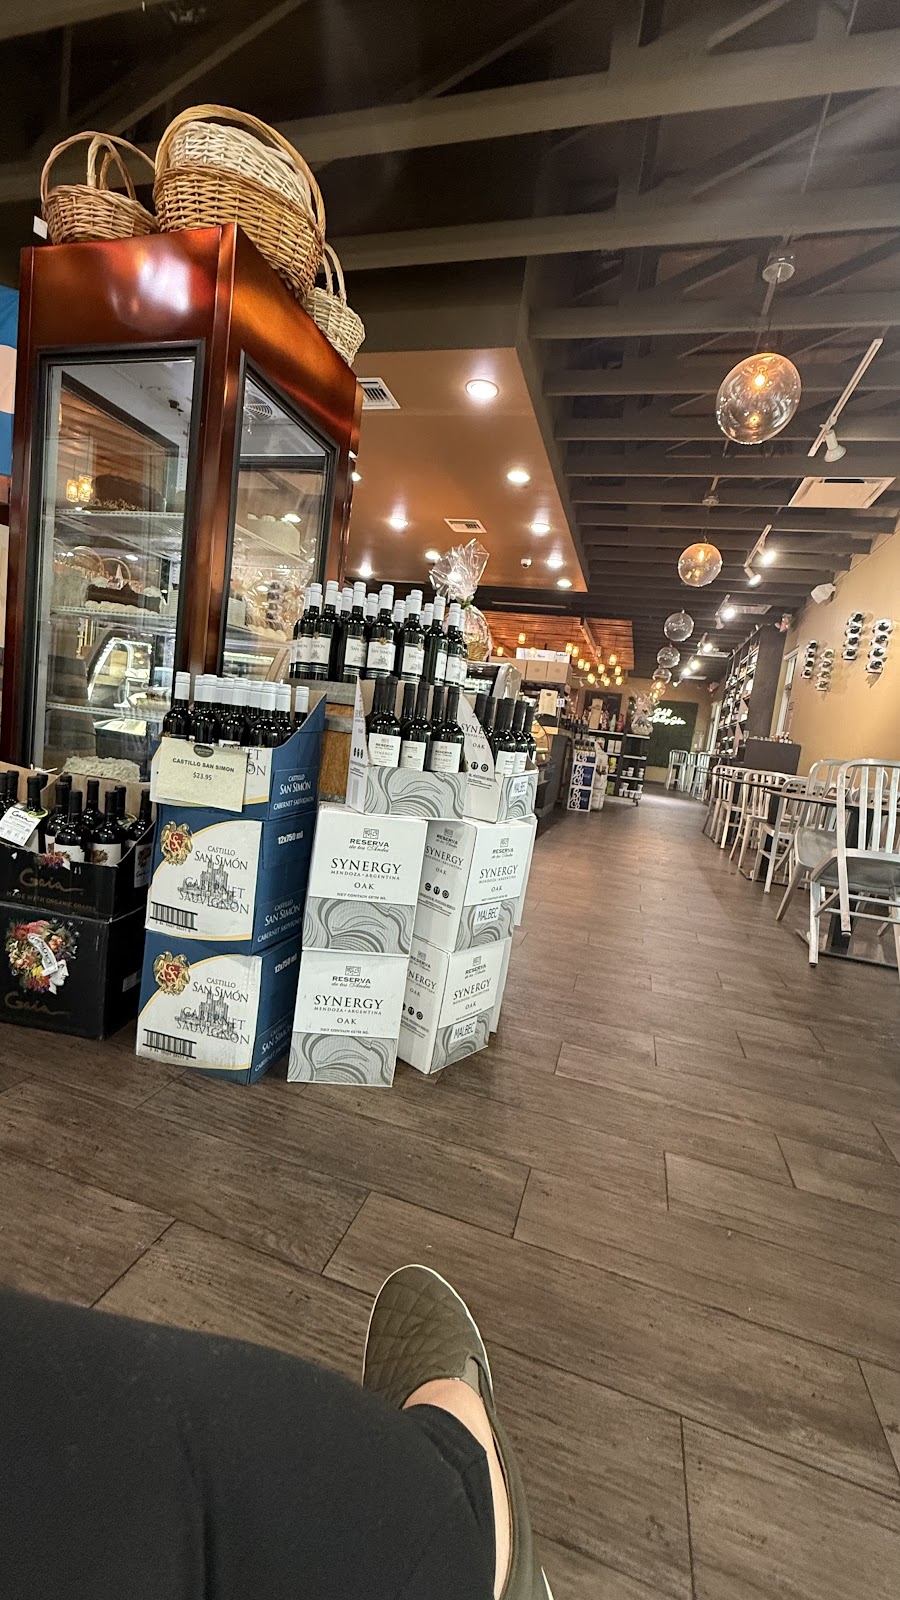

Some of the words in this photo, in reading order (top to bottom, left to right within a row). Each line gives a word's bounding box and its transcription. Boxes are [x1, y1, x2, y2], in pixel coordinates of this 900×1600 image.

[172, 757, 202, 767] CASTILLO
[215, 764, 235, 773] SIMON
[193, 771, 213, 781] $23.95
[287, 773, 306, 782] CASTILLO
[279, 783, 292, 795] SAN
[273, 800, 294, 811] CABERNET
[277, 833, 296, 845] 12x750
[349, 838, 390, 848] RESERVA
[436, 834, 458, 845] RESERVA
[207, 845, 236, 857] CASTILLO
[425, 845, 465, 867] SYNERGY
[491, 847, 514, 855] RESERVA
[194, 850, 213, 863] SAN
[214, 854, 249, 871] SIMÓN
[330, 857, 402, 875] SYNERGY
[330, 870, 362, 878] MENDOZA
[365, 873, 401, 881] ARGENTINA
[435, 866, 448, 876] OAK
[479, 864, 519, 879] SYNERGY
[184, 876, 246, 899] CABERNET
[354, 881, 375, 890] OAK
[490, 885, 503, 893] OAK
[178, 890, 250, 915] SAUVIGNON
[264, 912, 279, 927] SAN
[477, 906, 499, 921] MALBEC
[257, 924, 281, 943] CABERNET
[464, 963, 487, 975] RESERVA
[206, 977, 237, 989] CASTILLO
[331, 975, 372, 985] RESERVA
[192, 981, 212, 995] SAN
[214, 986, 249, 1003] SIMÓN
[453, 977, 492, 1001] SYNERGY
[313, 994, 384, 1010] SYNERGY
[465, 1001, 477, 1010] OAK
[313, 1006, 344, 1014] MENDOZA
[182, 1006, 247, 1031] CABERNET
[336, 1017, 357, 1025] OAK
[176, 1020, 251, 1045] SAUVIGNON
[453, 1021, 476, 1040] MALBEC
